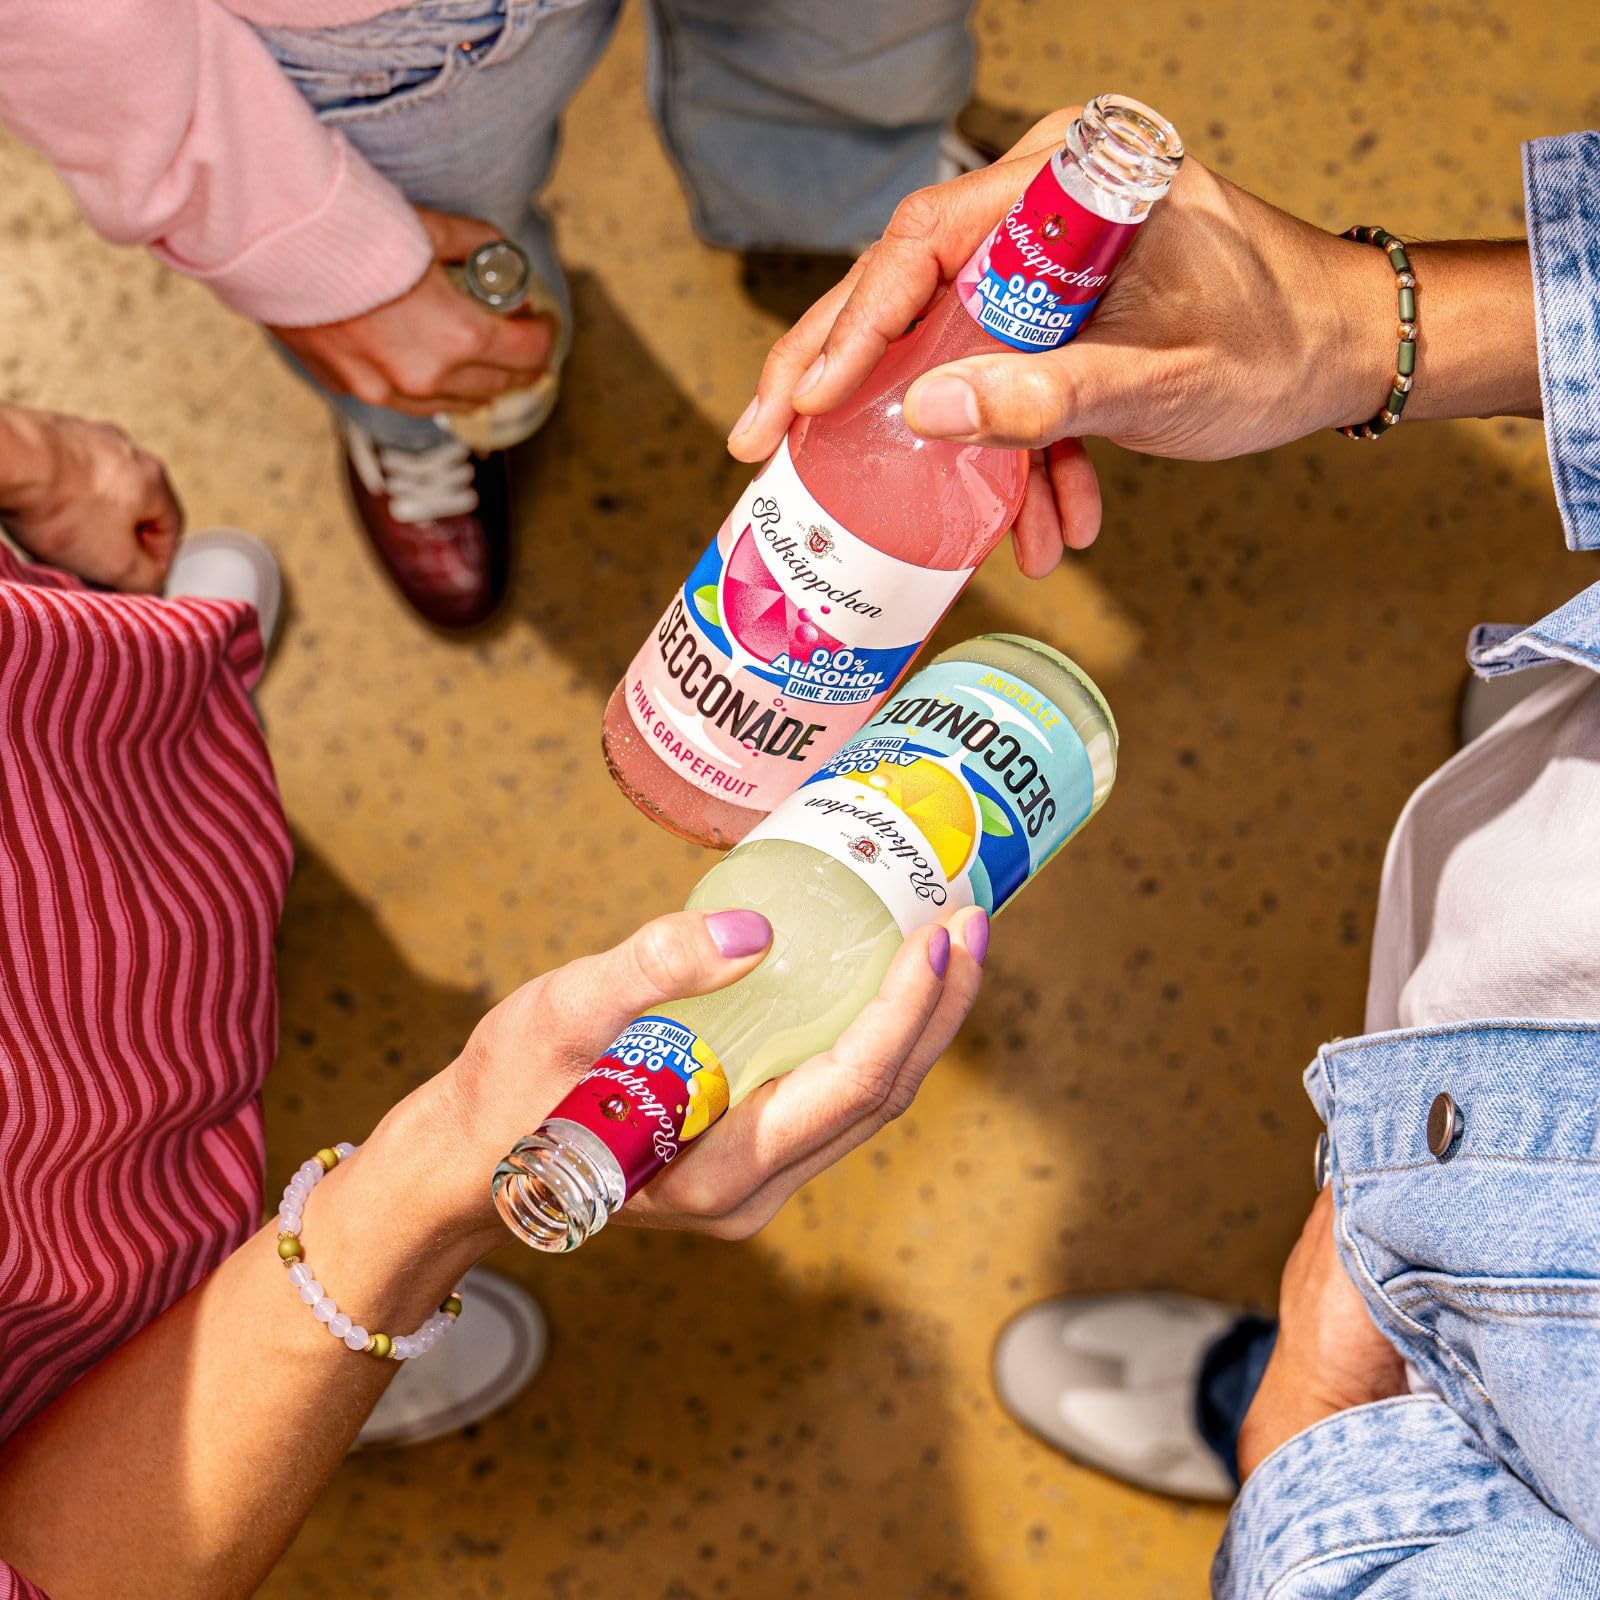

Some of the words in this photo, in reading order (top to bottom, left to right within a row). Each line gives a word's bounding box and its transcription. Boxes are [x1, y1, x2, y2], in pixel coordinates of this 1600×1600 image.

[1005, 193, 1108, 288] Rotkäppchen
[977, 277, 1073, 328] ALKOHOL
[1008, 275, 1061, 309] 0,0%
[984, 306, 1014, 333] OHNE
[1014, 323, 1060, 344] ZUCKER
[752, 496, 884, 619] Rotkäppchen
[658, 599, 827, 762] SECCONADE
[772, 653, 885, 687] ALKOHOL
[811, 649, 866, 673] 0,0%
[789, 682, 823, 699] OHNE
[825, 688, 871, 701] ZUCKER
[978, 672, 1062, 732] ZITRONE
[632, 679, 656, 726] PINK
[653, 719, 758, 798] GRAPEFRUIT
[869, 739, 902, 749] OHNE
[869, 698, 1057, 839] SECCONADE
[803, 797, 948, 907] Rotkäppchen
[611, 1034, 702, 1075] ALKOHO
[657, 1024, 689, 1047] OHNE
[613, 1047, 665, 1072] 0,0%
